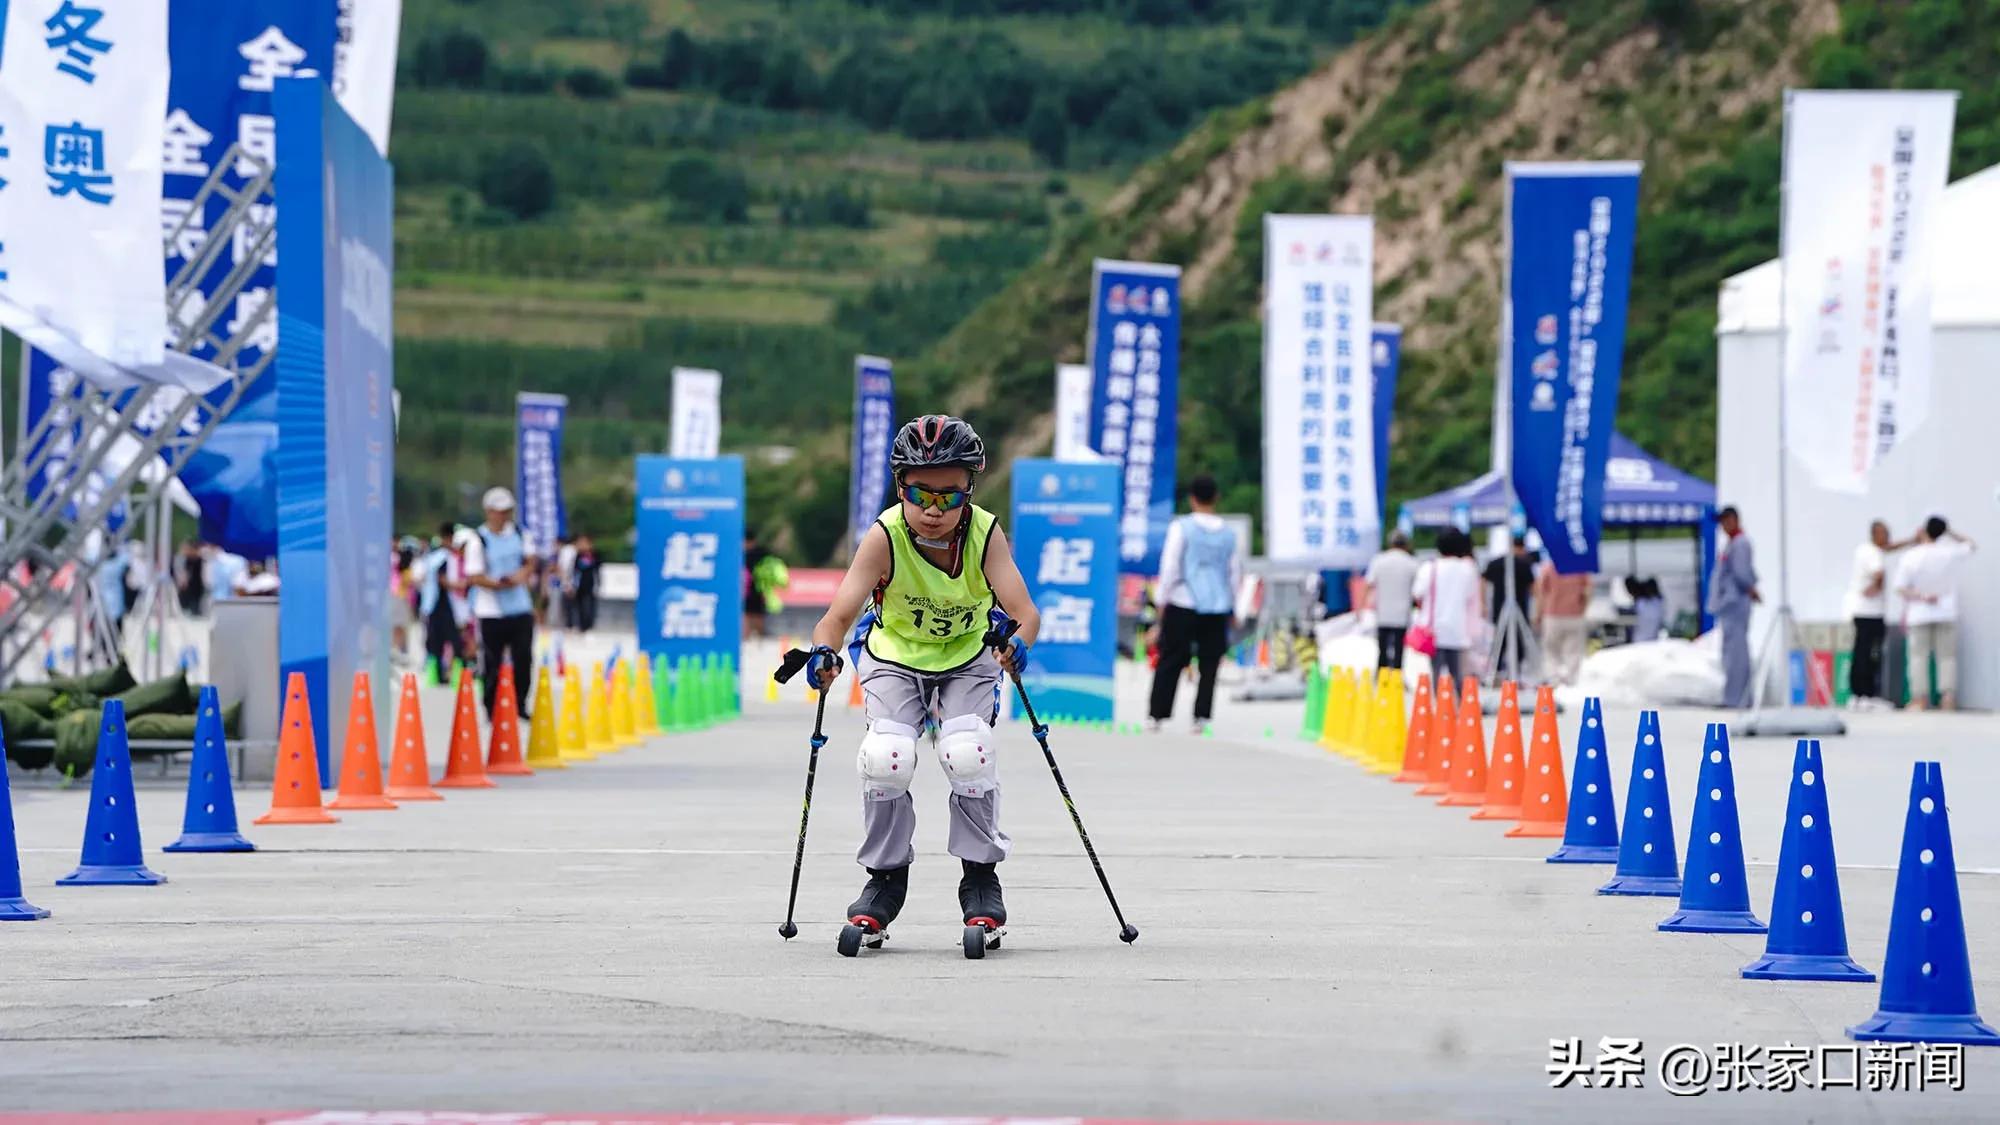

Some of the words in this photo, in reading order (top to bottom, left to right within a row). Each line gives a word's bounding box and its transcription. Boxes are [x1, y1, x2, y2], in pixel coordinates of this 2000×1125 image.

[45, 0, 114, 205] 冬奥
[660, 531, 719, 639] 起点
[1037, 537, 1095, 644] 起点
